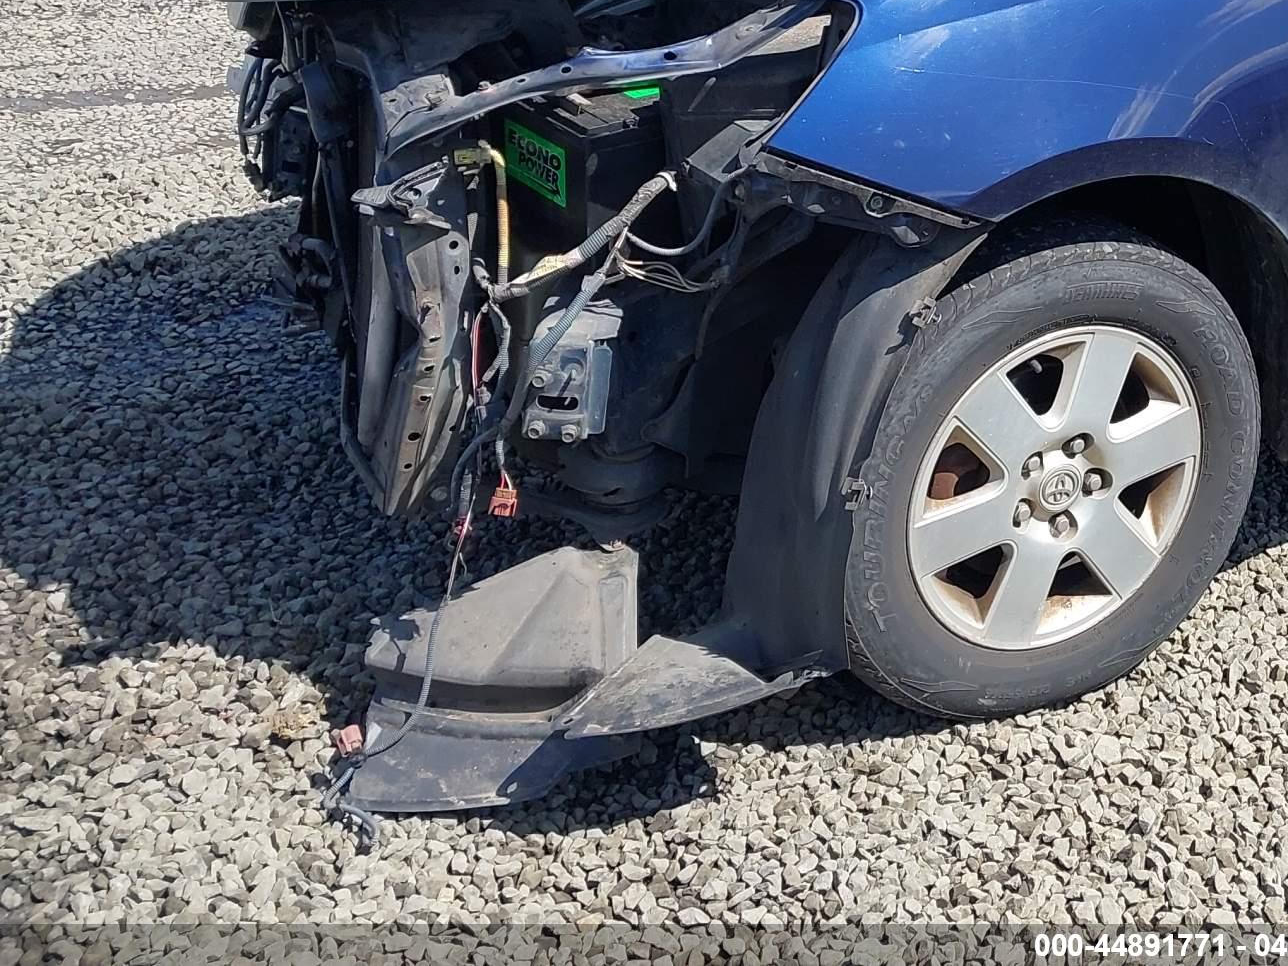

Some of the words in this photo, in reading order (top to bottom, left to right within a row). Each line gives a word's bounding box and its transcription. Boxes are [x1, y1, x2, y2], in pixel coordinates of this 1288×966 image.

[508, 128, 562, 171] ECONO
[519, 153, 559, 188] POWER
[863, 434, 905, 633] TOURING
